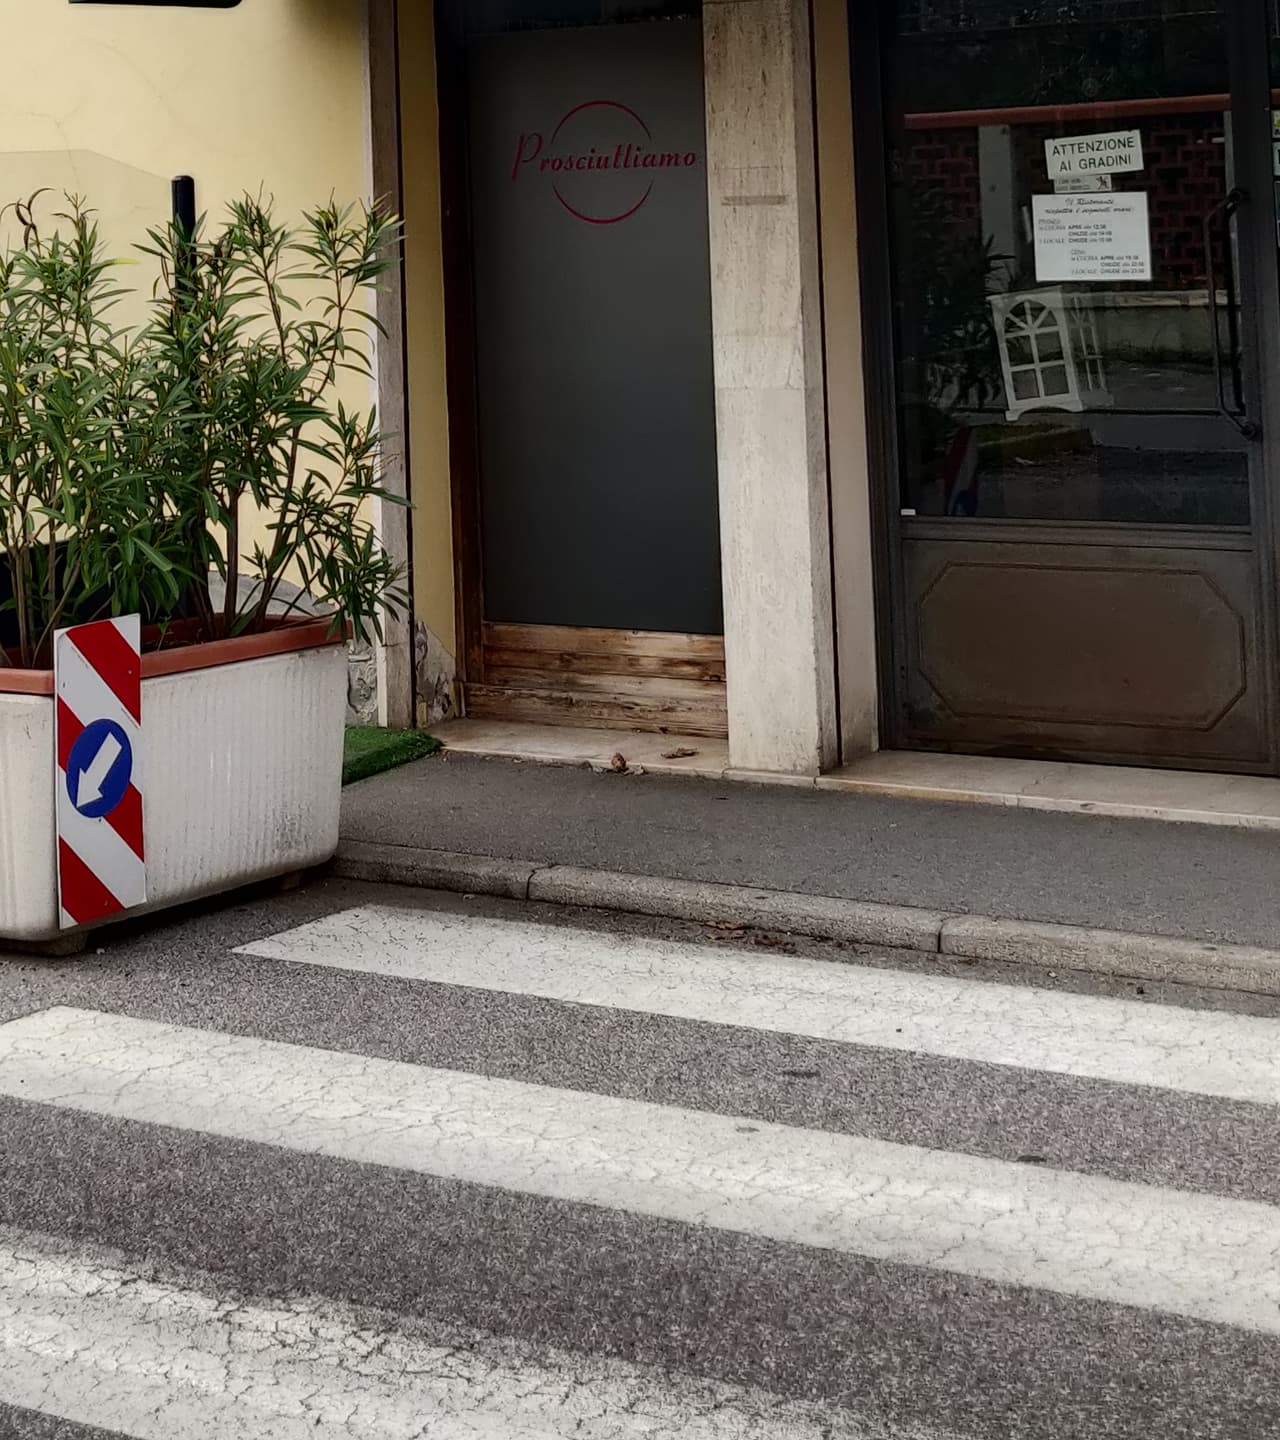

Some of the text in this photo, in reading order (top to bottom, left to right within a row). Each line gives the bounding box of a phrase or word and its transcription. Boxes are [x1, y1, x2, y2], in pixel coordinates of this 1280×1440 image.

[511, 131, 696, 182] Prosciuttiamo
[1052, 136, 1135, 157] ATTENZIONE
[1059, 154, 1132, 173] AI GRADINI
